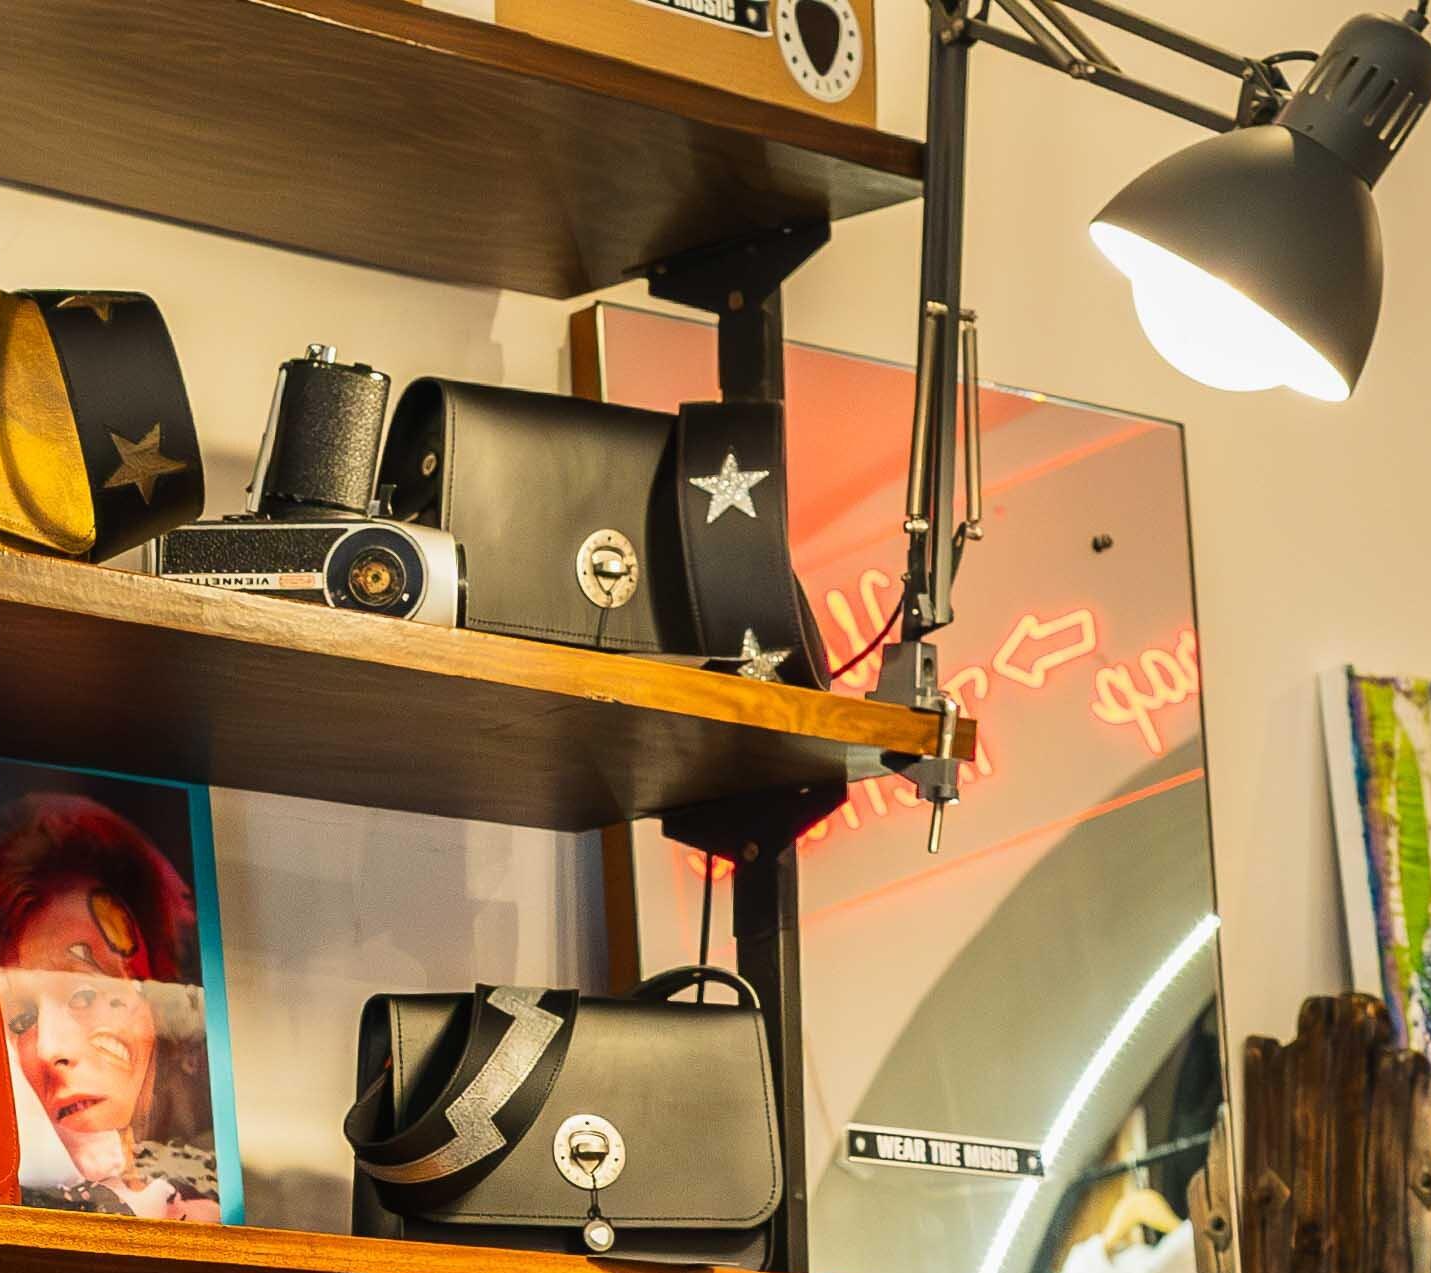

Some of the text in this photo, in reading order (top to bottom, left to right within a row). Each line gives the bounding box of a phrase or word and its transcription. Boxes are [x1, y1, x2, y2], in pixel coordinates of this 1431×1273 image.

[876, 1135, 1018, 1172] WEAR THE MUSIC
